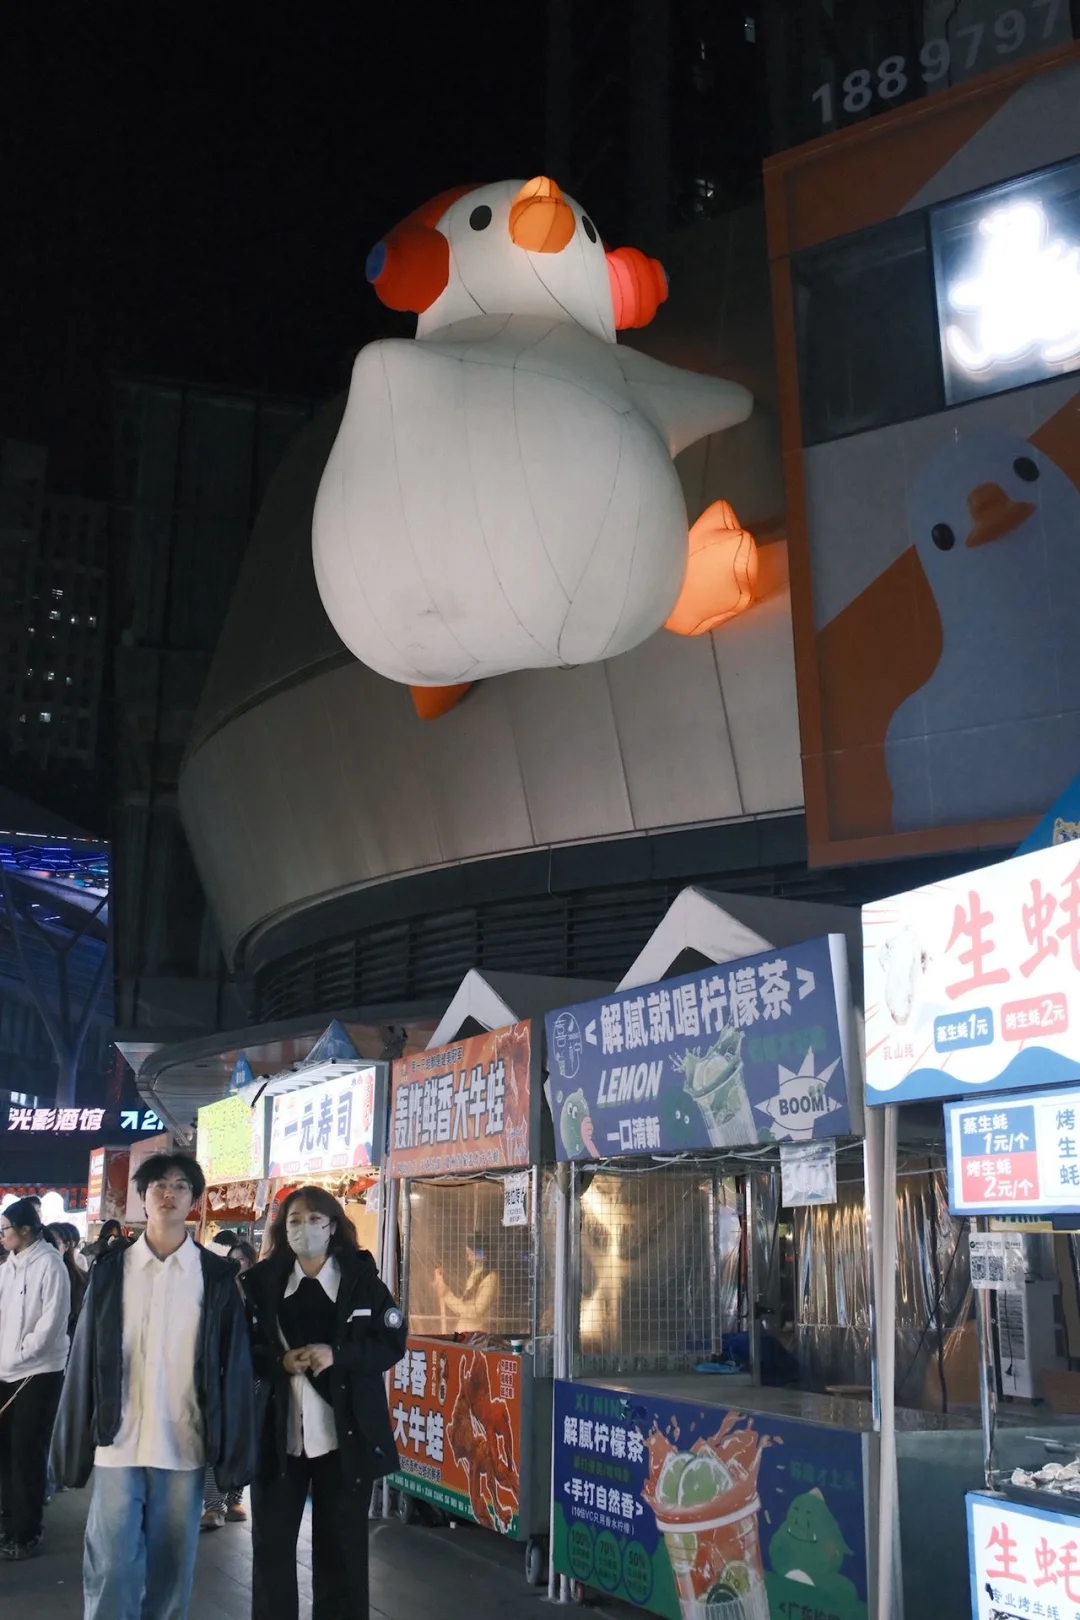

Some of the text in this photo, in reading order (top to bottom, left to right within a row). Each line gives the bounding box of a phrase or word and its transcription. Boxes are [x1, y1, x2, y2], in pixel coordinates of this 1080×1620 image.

[944, 858, 1080, 1000] 生蚝
[394, 1060, 505, 1149] 轰炸鲜香大牛蛙
[596, 1060, 664, 1106] LEMON
[779, 1095, 830, 1116] BOOM!
[284, 1090, 353, 1152] 一元寿司
[607, 1116, 661, 1150] 一口清新
[963, 1112, 1008, 1134] 蒸生蚝
[983, 1132, 1029, 1155] 1元/个
[966, 1158, 1012, 1177] 烤生蚝
[1056, 1108, 1080, 1187] 烤生蚝
[983, 1176, 1034, 1199] 2元/个
[392, 1401, 444, 1463] 大牛蛙
[563, 1415, 645, 1463] 解腻柠檬茶
[985, 1521, 1080, 1605] 生蚝
